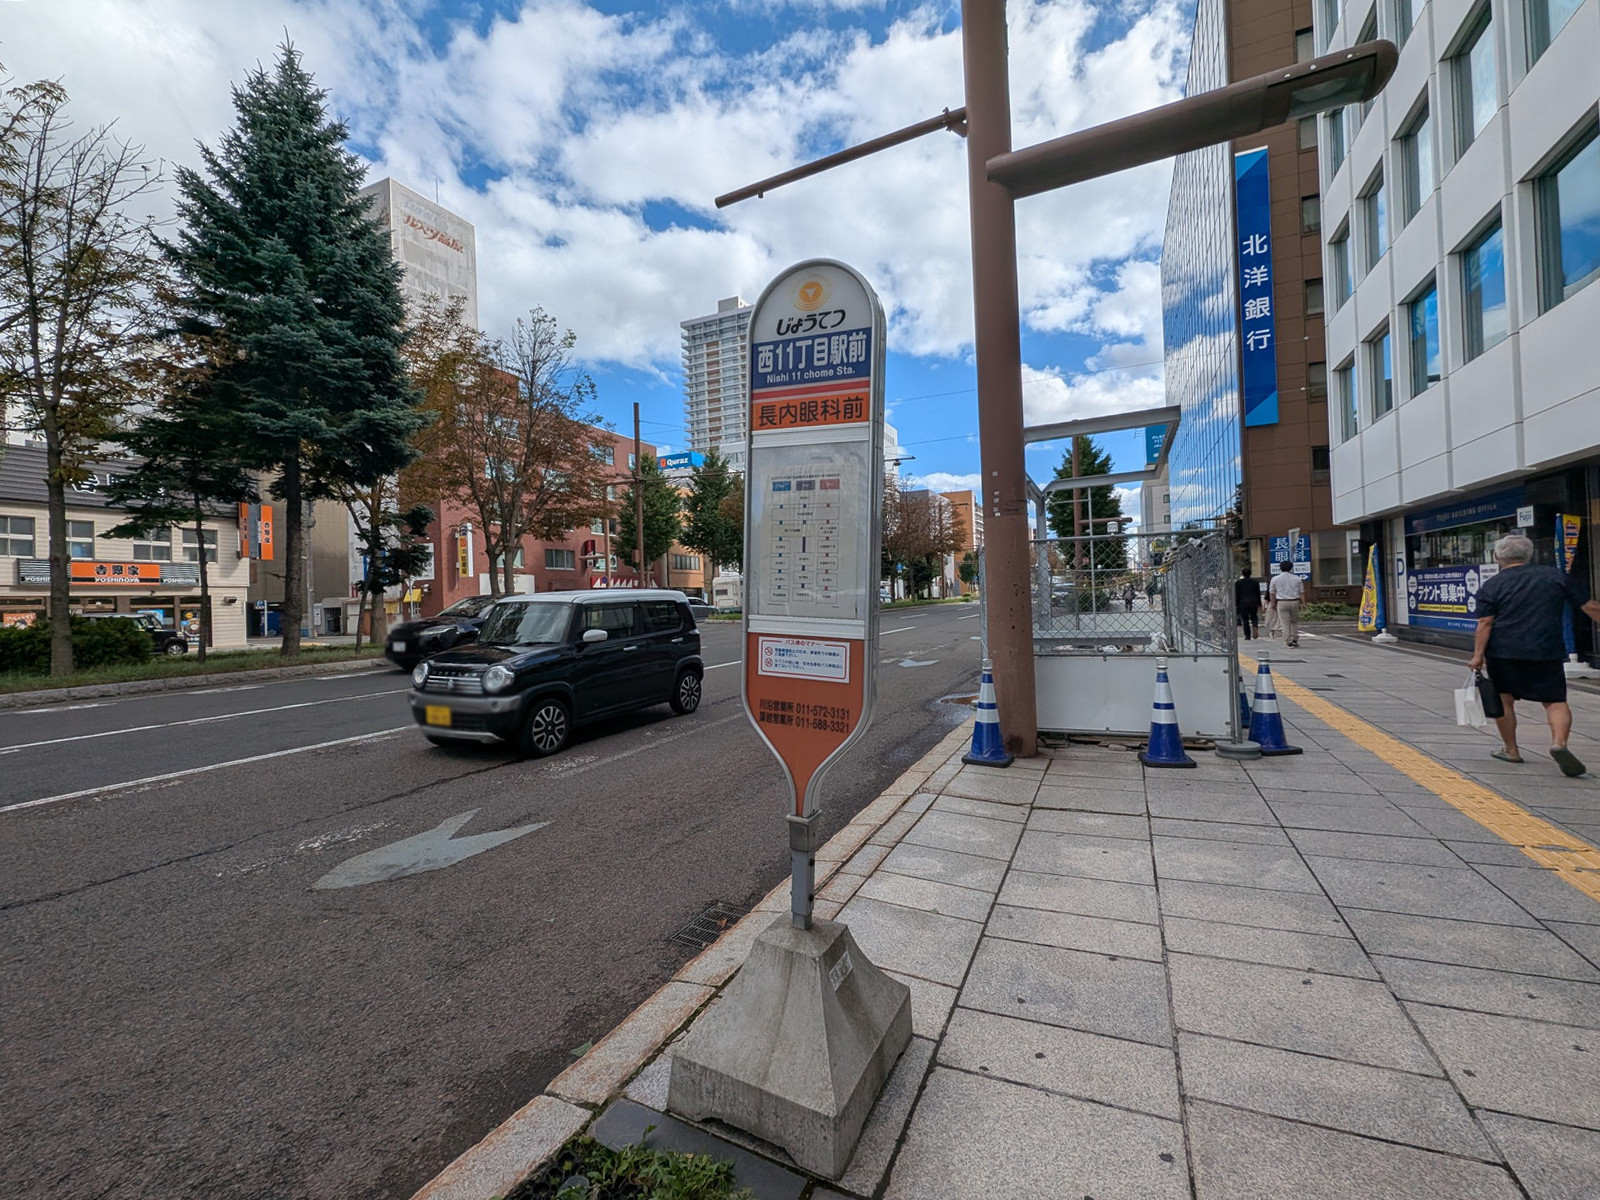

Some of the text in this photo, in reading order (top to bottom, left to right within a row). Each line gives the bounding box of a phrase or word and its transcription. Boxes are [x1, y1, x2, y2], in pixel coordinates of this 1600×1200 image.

[1242, 234, 1271, 351] 北洋銀行
[776, 309, 846, 336] じょうてつ
[758, 332, 866, 373] 西11丁目駅前
[766, 366, 855, 383] Nishi 11 chome Sta.
[759, 396, 864, 427] 長内眼科前
[667, 458, 689, 467] Quraz
[1275, 550, 1306, 562] 眼科
[1418, 583, 1466, 603] テナント募集中
[796, 703, 850, 720] 011-572-3131
[796, 716, 850, 733] 011-588-3321
